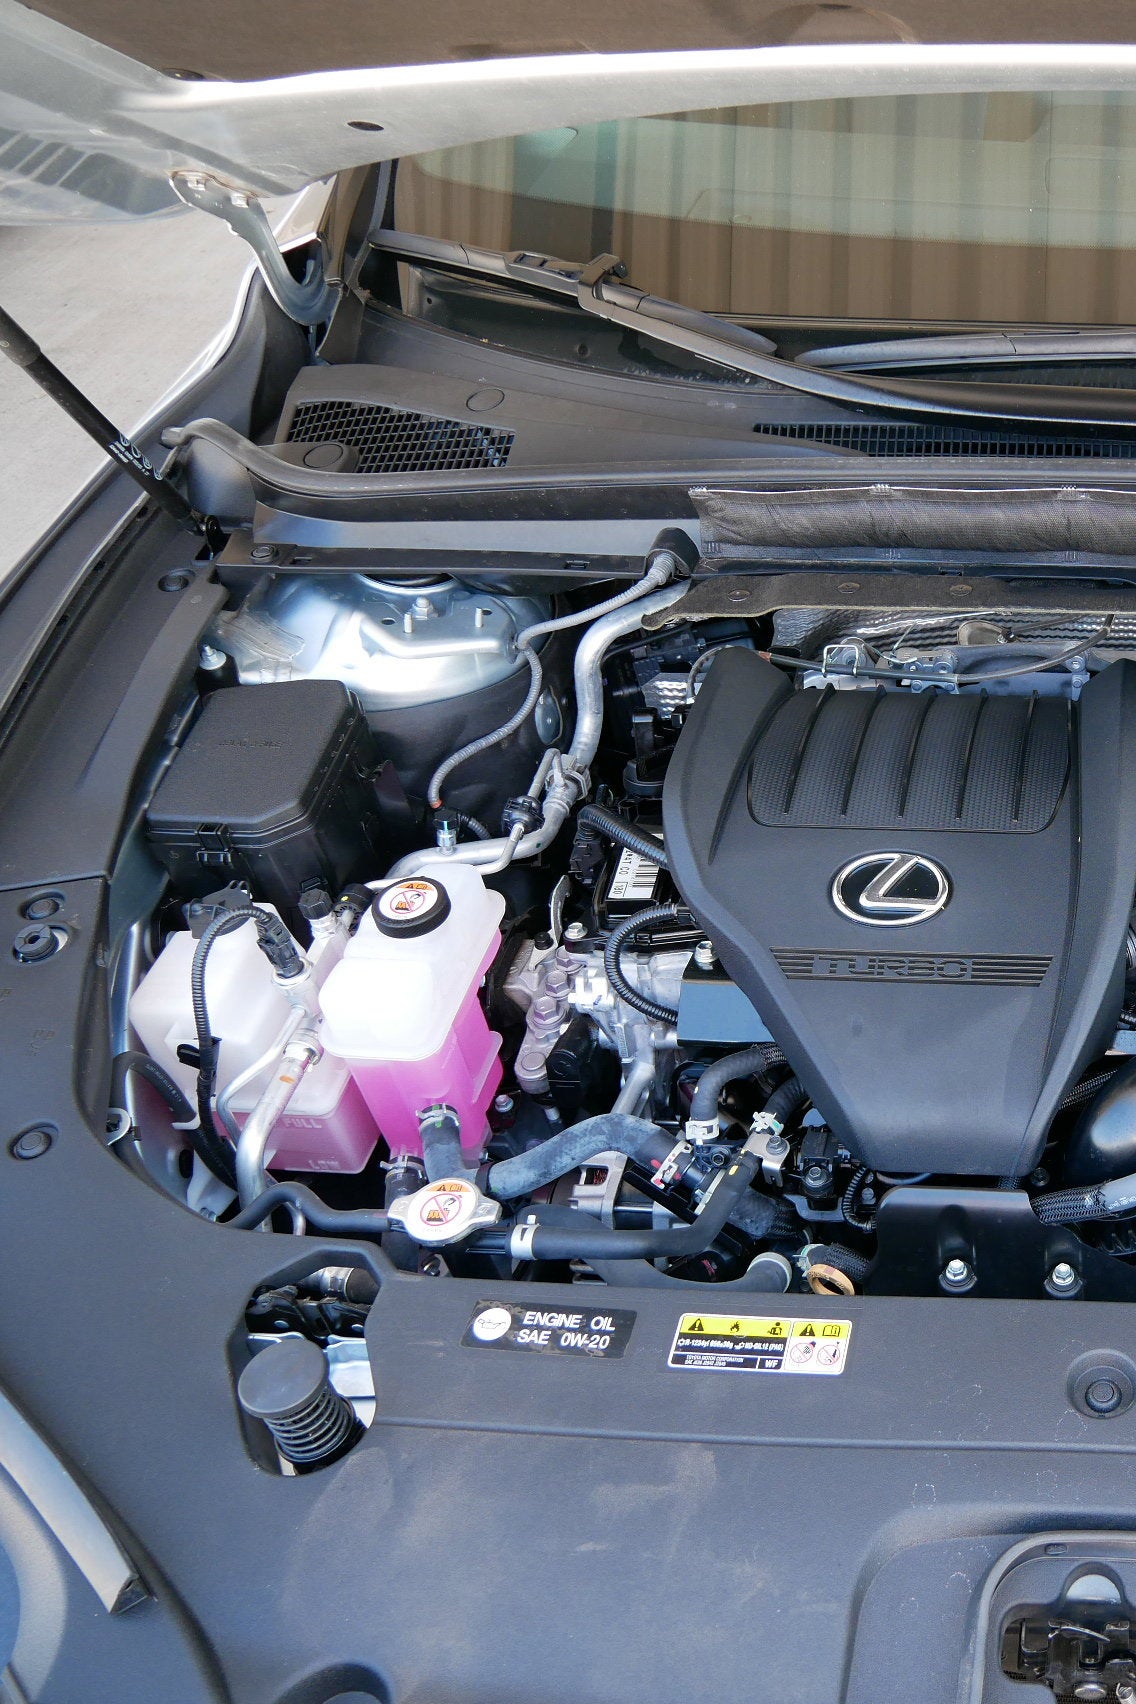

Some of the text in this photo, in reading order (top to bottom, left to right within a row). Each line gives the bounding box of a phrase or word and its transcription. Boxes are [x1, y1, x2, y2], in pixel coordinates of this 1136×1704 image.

[814, 953, 972, 980] TURBO
[283, 1118, 322, 1129] FULL
[308, 1160, 341, 1170] LOW
[522, 1311, 616, 1331] ENGINE OIL
[517, 1329, 610, 1350] SAE 0W-20
[765, 1360, 779, 1368] WF
